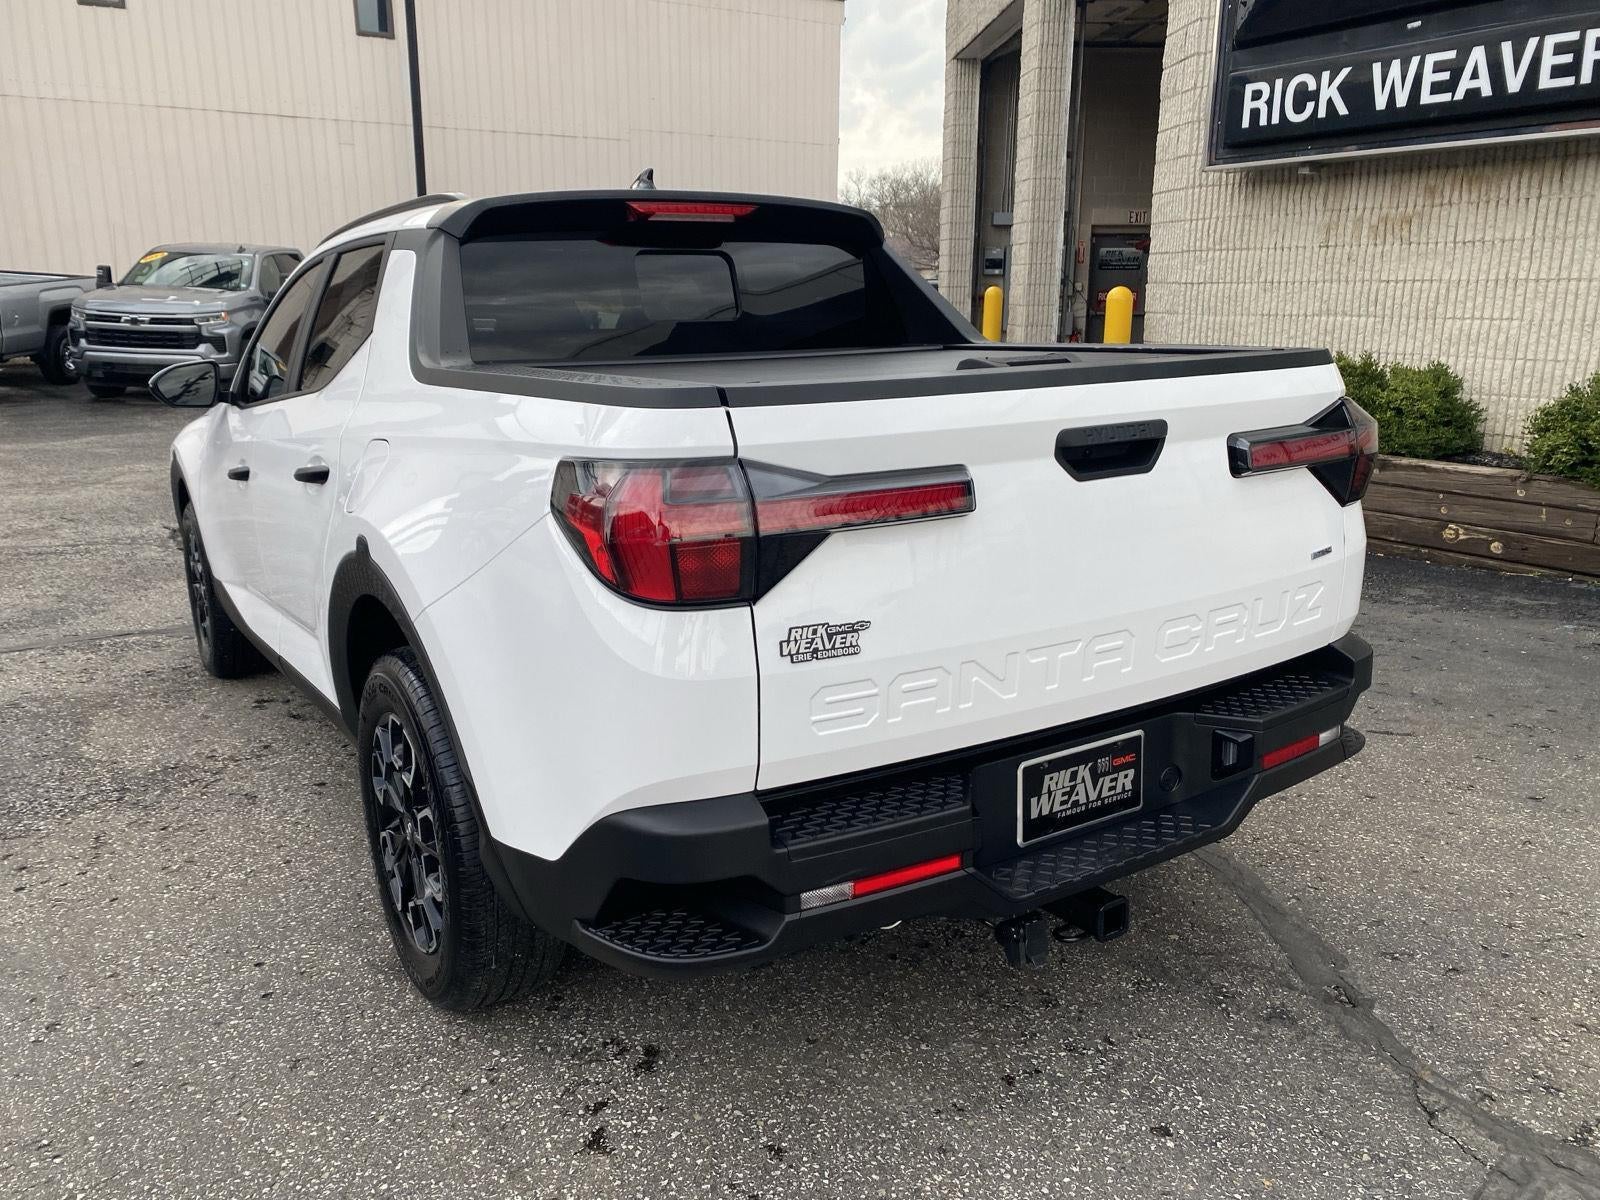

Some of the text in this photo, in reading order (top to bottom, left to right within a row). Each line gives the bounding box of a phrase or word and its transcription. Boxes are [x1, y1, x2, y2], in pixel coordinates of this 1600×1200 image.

[1241, 66, 1353, 129] RICK
[1129, 211, 1147, 223] EXIT
[789, 624, 828, 641] RICK
[827, 624, 853, 634] GMC
[781, 632, 859, 656] WEAVER
[810, 580, 1326, 736] SANTA CRUZ
[1112, 753, 1136, 766] GMC
[1042, 761, 1095, 794] RICK
[1030, 768, 1135, 820] WEAVER
[1057, 790, 1132, 819] FAMOUS FOR SERVICE
